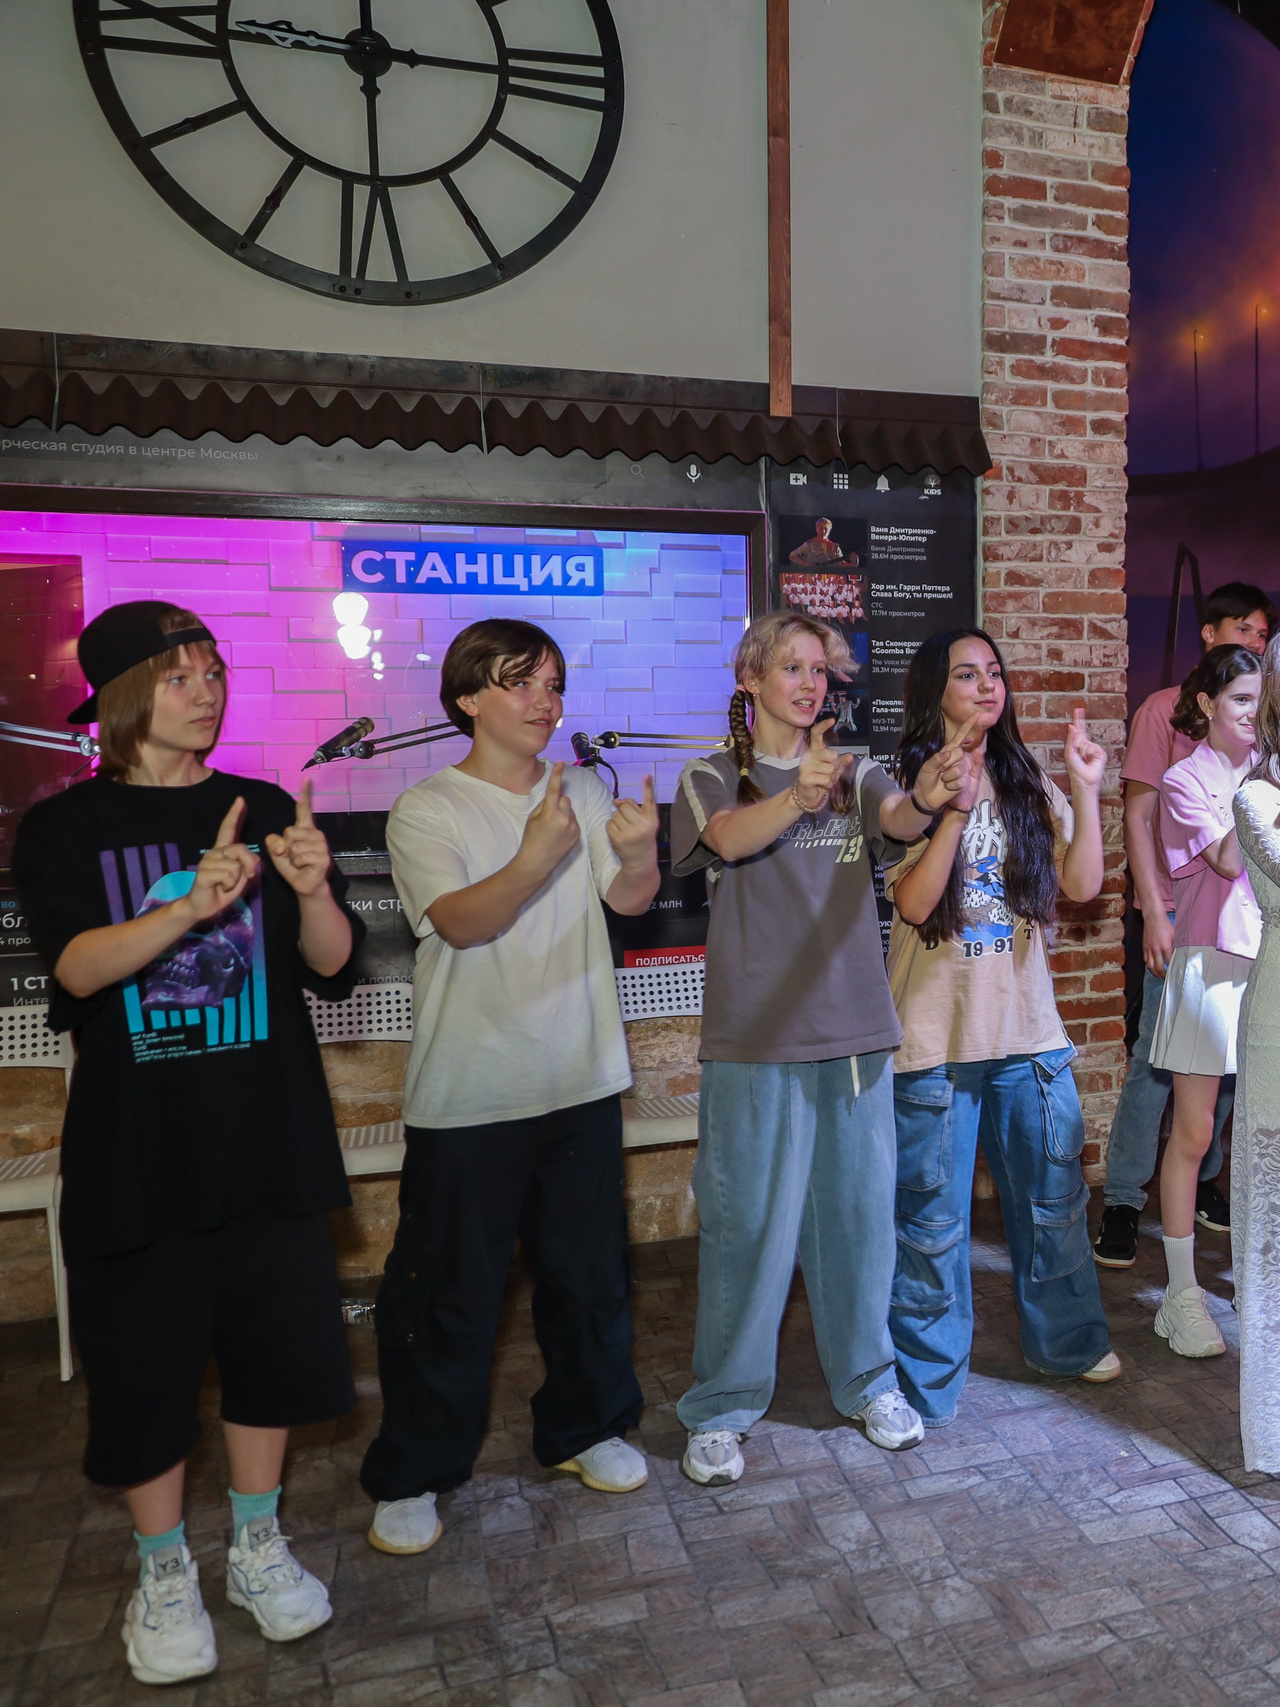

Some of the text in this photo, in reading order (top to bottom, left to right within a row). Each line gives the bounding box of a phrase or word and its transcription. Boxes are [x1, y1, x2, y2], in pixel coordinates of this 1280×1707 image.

[0, 439, 258, 460] рческая студия в центре Москвы
[870, 533, 928, 543] Венера-Юпитер
[351, 550, 595, 591] СТАНЦИЯ
[871, 583, 885, 591] Хор
[922, 584, 951, 592] Поттера
[659, 900, 683, 909] МЛН
